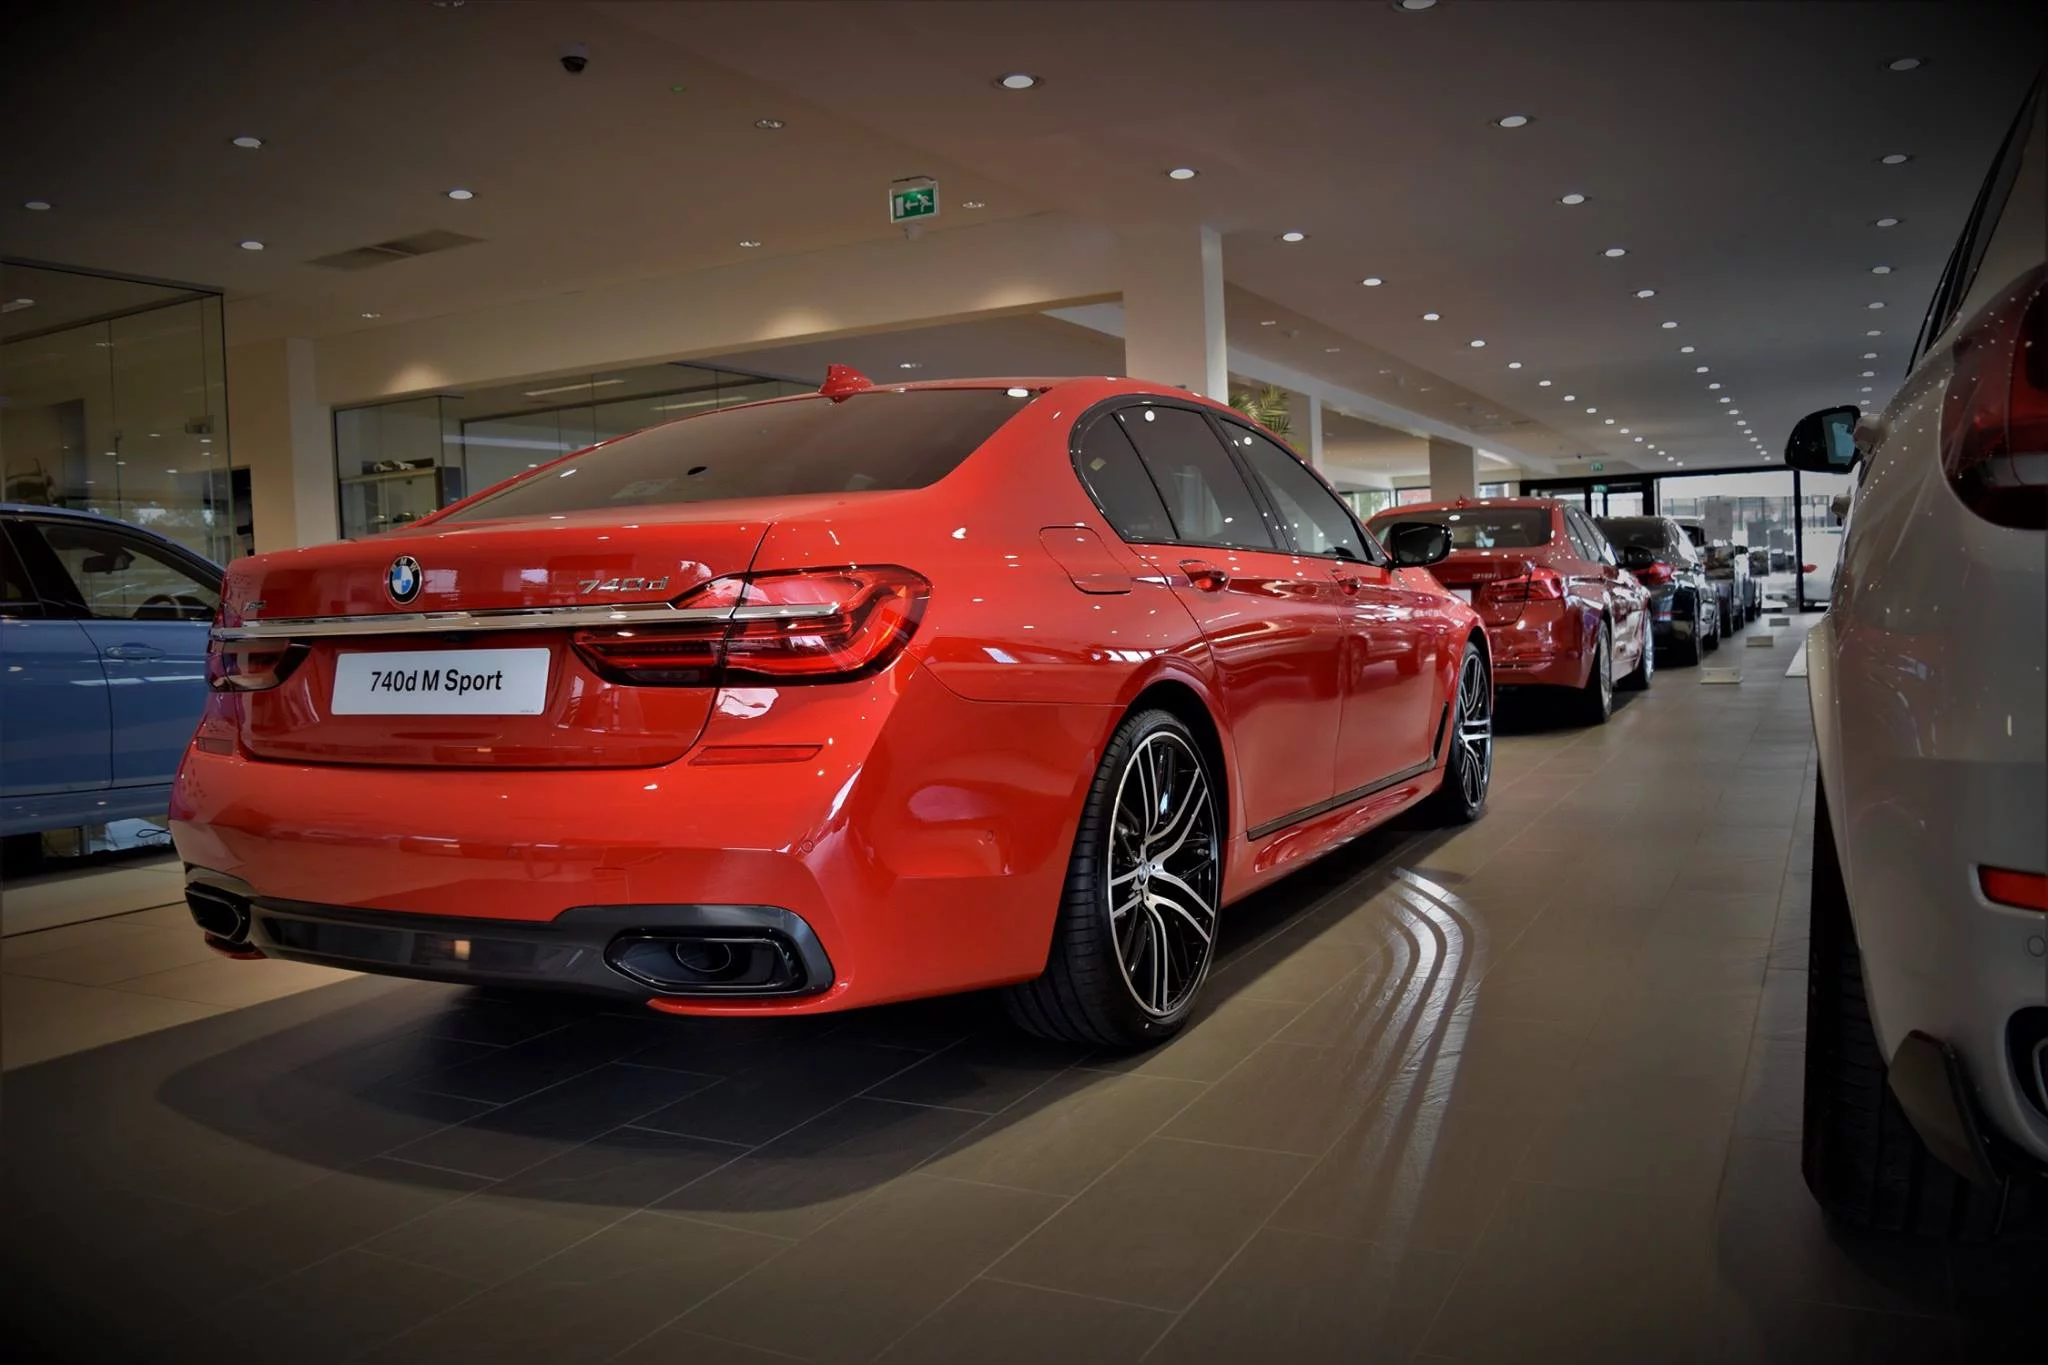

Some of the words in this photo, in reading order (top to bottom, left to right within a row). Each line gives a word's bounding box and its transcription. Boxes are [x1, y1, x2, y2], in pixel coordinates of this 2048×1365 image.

[579, 576, 670, 594] 740d
[371, 670, 418, 692] 740d
[422, 669, 440, 691] M
[444, 668, 503, 695] Sport
